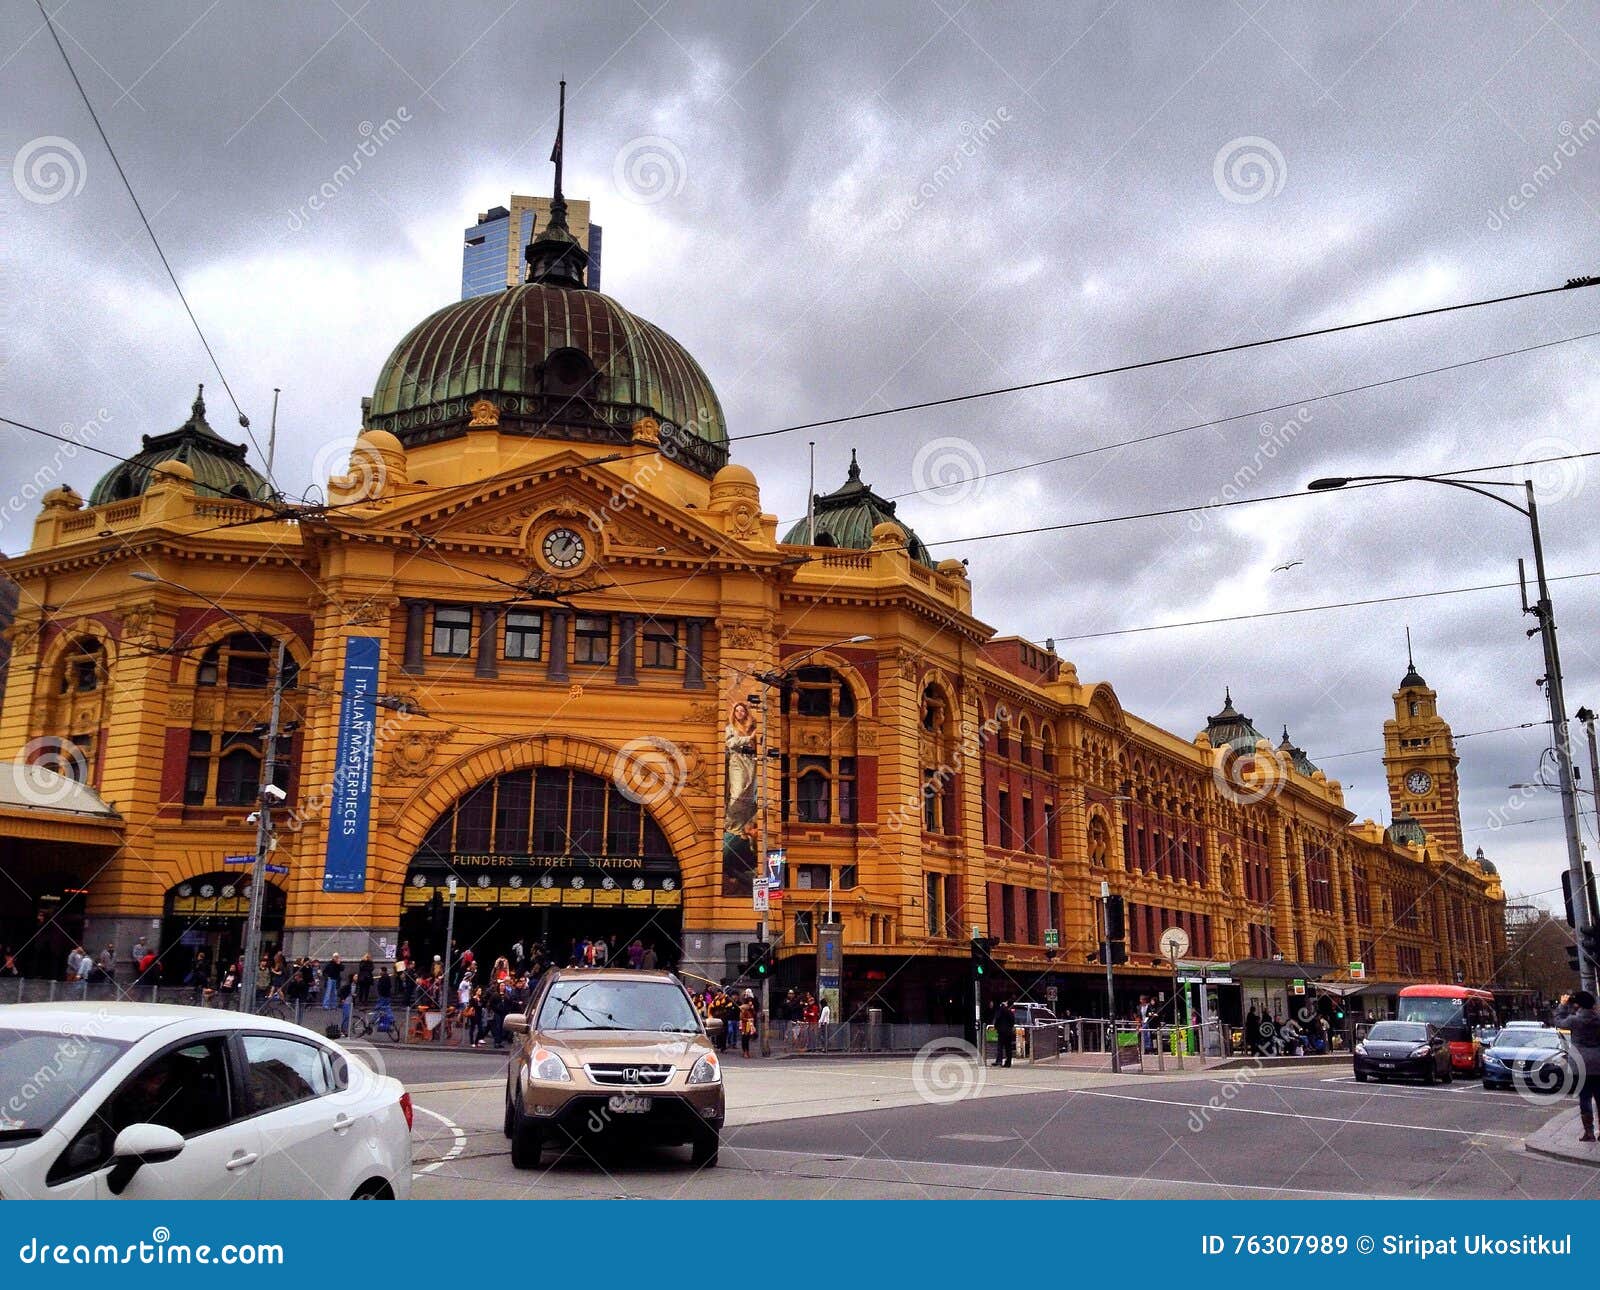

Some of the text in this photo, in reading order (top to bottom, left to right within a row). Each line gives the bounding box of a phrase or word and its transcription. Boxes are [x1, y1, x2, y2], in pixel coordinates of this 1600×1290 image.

[352, 679, 367, 729] ITALIAN
[343, 735, 362, 835] MASTERPIECES
[453, 855, 643, 869] FLINDERS STREET STATION
